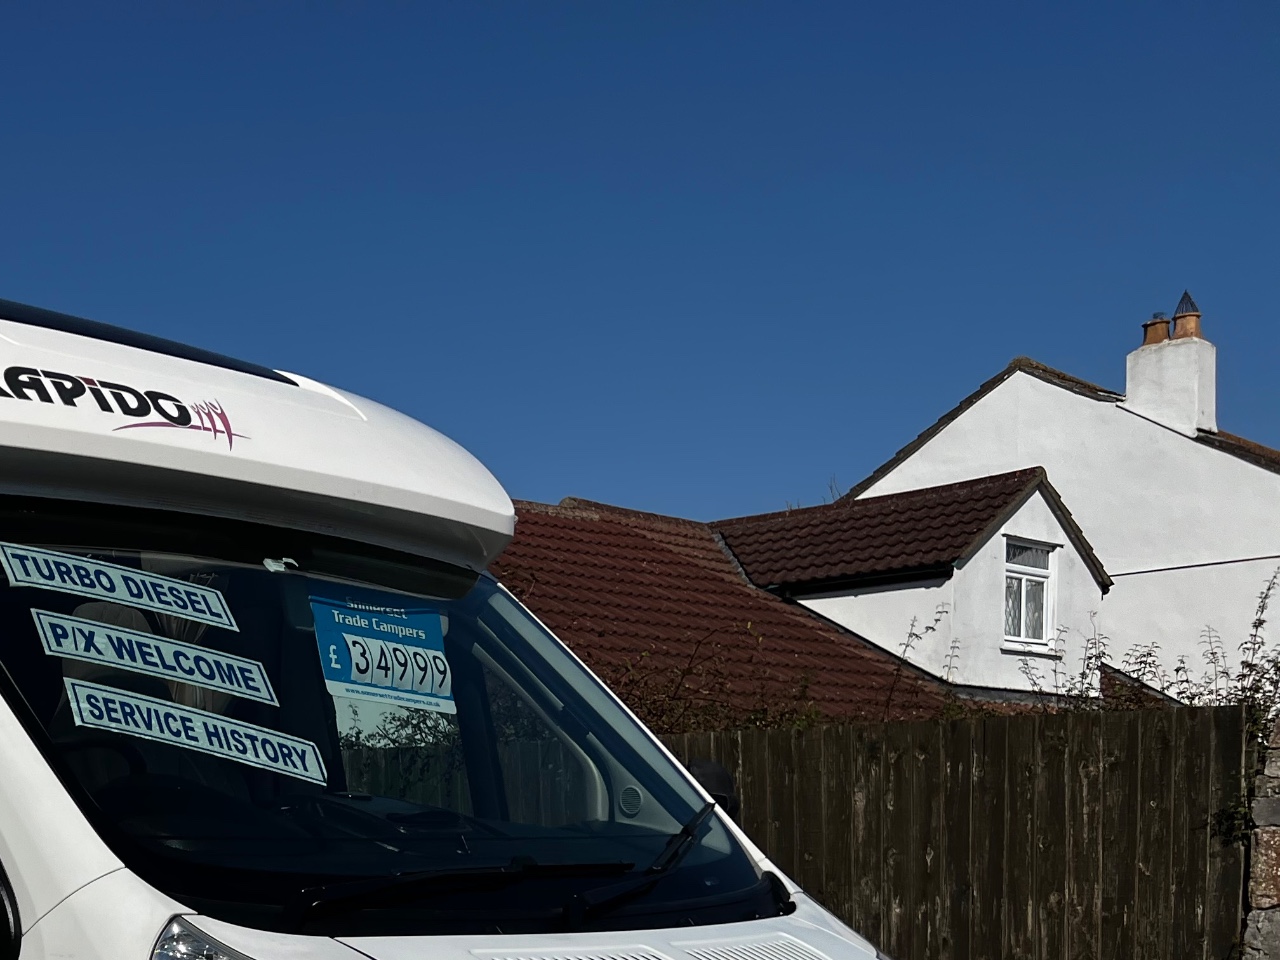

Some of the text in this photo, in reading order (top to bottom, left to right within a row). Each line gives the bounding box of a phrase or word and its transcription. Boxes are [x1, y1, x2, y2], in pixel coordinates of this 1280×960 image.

[10, 552, 224, 619] TURBO DIESEL
[48, 622, 262, 693] P/X WELCOME
[332, 610, 426, 640] Trade Campers
[352, 640, 447, 688] 34999
[85, 693, 310, 773] SERVICE HISTORY
